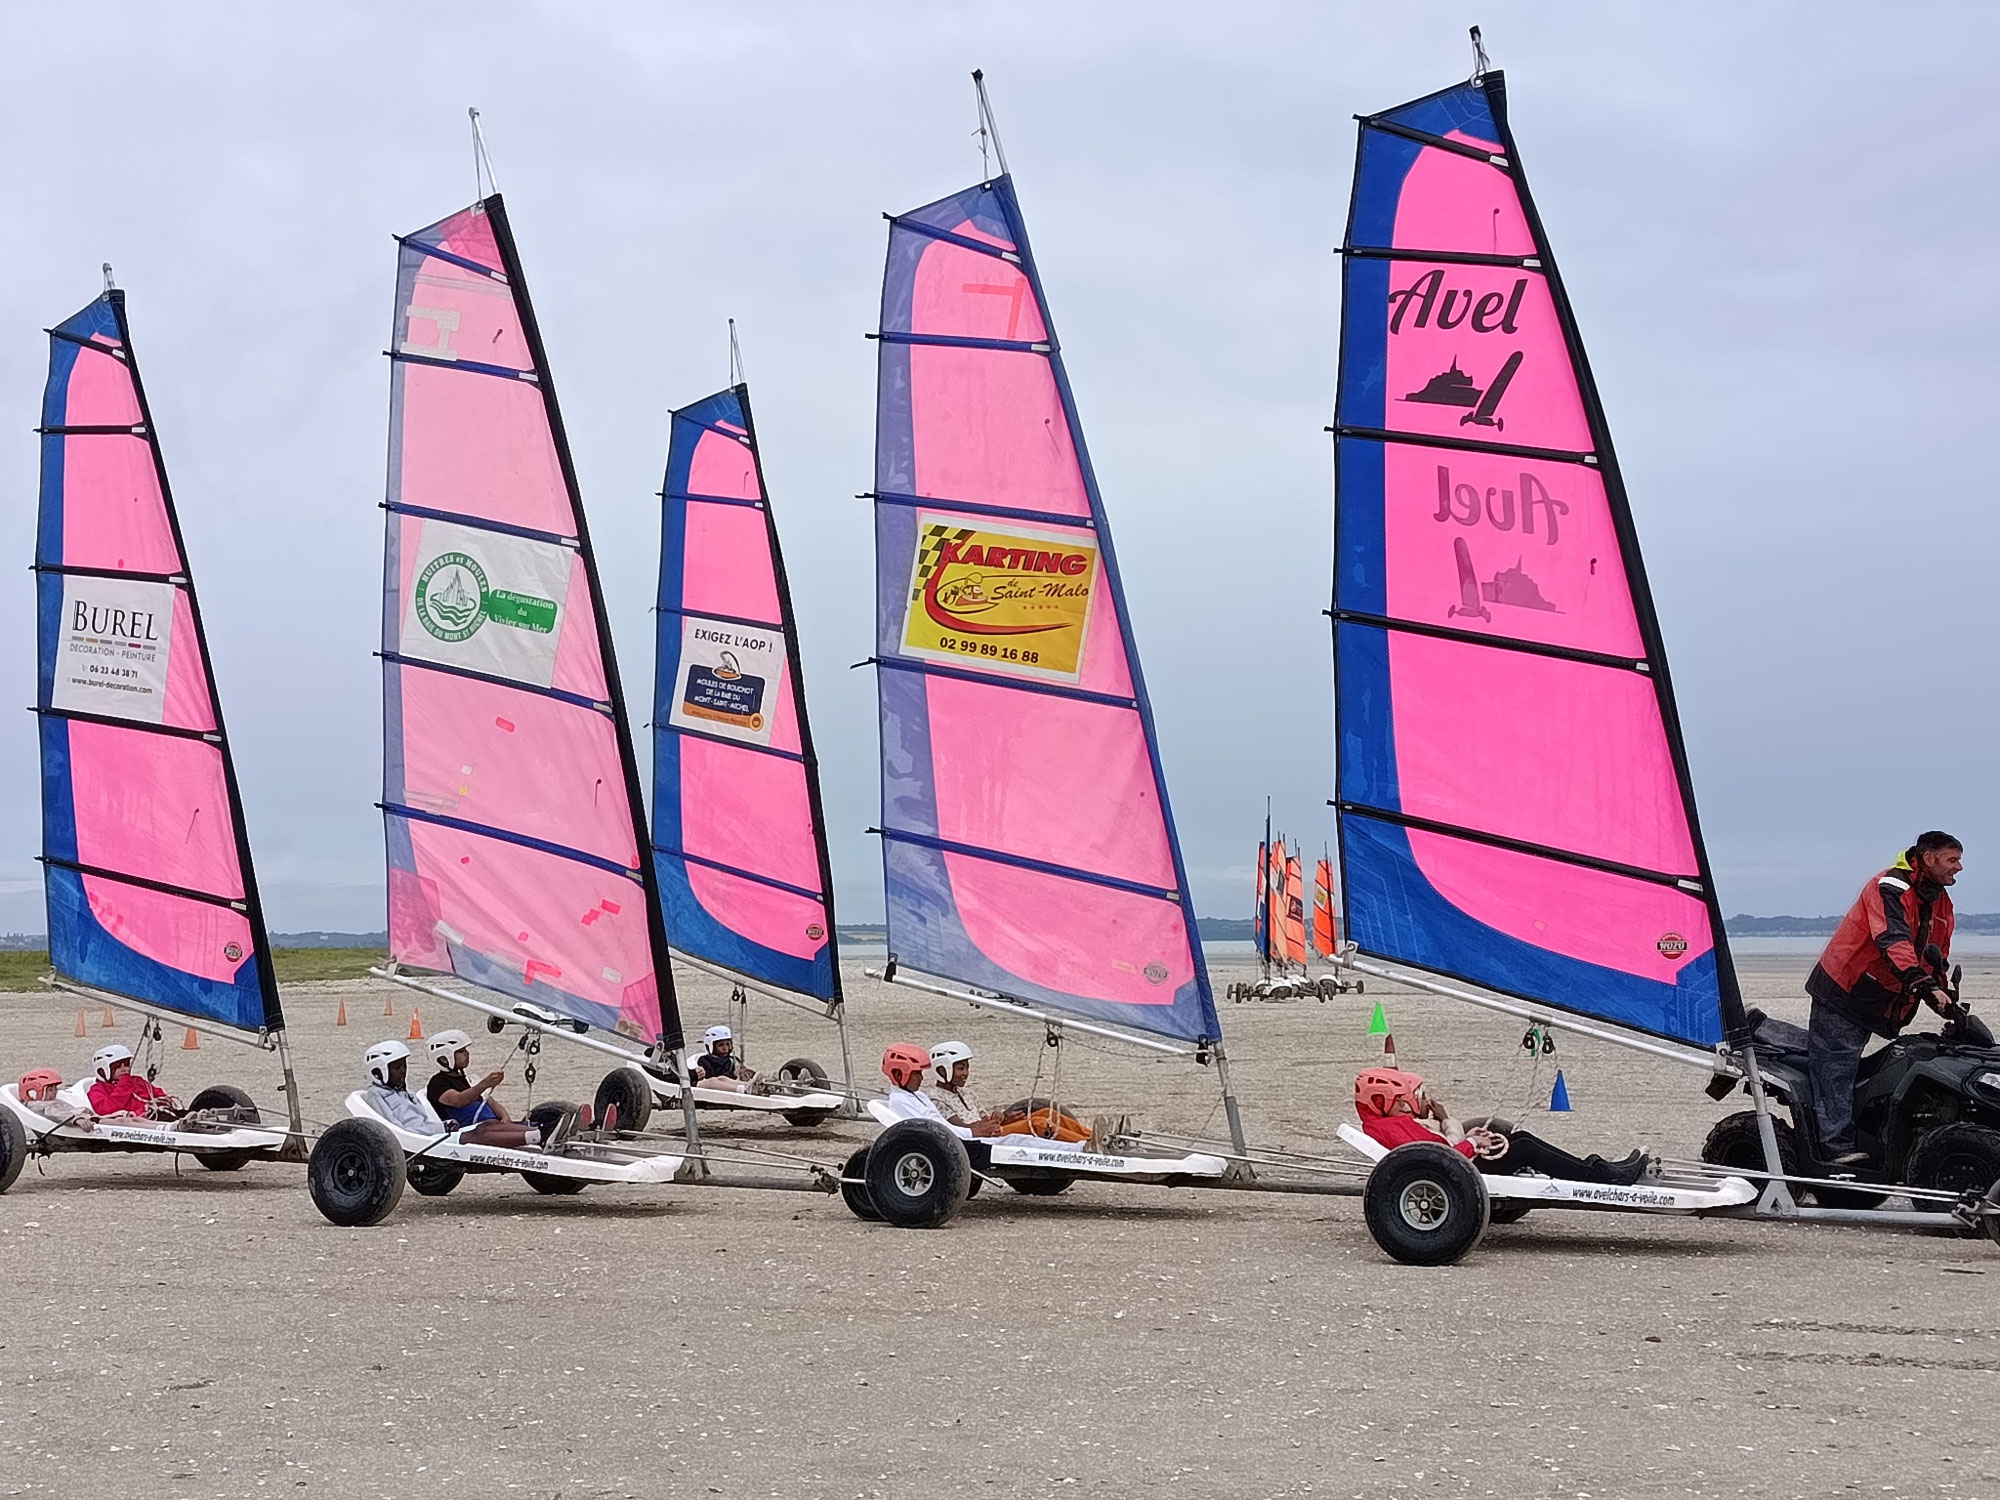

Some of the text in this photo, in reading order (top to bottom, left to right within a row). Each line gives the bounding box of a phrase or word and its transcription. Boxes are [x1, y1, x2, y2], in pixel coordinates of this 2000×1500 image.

[1388, 269, 1528, 335] Avel
[940, 541, 1088, 576] KARTING
[991, 583, 1089, 600] Saint-Malo
[1006, 578, 1019, 588] de
[496, 590, 554, 610] La dégustation
[72, 600, 159, 640] BUREL
[494, 614, 517, 627] Vivier
[532, 623, 548, 634] Mer
[694, 628, 732, 645] EXIGEZ
[735, 636, 766, 651] L'AOP
[69, 643, 115, 656] DECORATION
[121, 650, 156, 663] PEINTURE
[939, 636, 1039, 664] 02 99 89 16 88
[89, 665, 99, 673] 06
[100, 666, 109, 674] 23
[71, 677, 153, 694] www.burel-decoration.com
[696, 678, 754, 695] MOULES DE BOUCHOT
[1572, 1187, 1675, 1206] www.avelchars-a-voile.com
